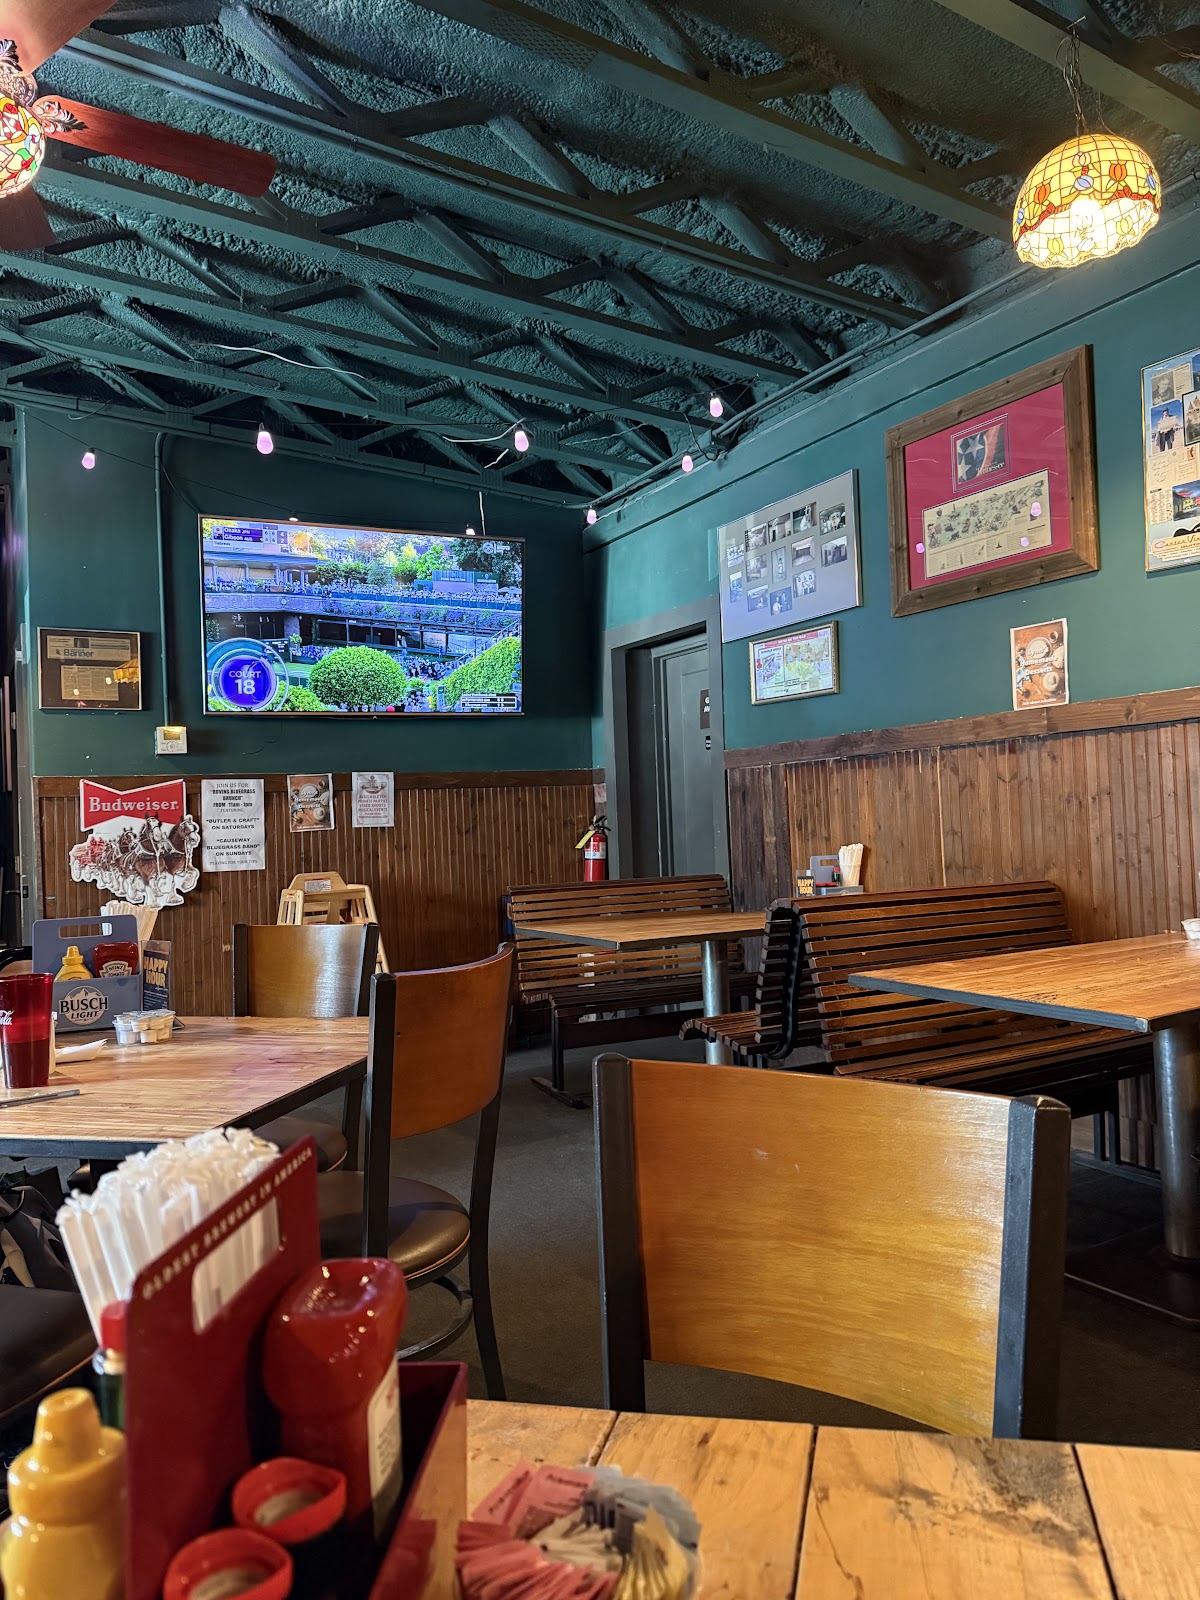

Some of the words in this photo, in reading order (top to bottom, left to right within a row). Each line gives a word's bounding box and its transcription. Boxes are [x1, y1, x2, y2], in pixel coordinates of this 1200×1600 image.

[63, 648, 94, 658] Banner
[1020, 656, 1058, 666] Homemade
[228, 670, 262, 678] COURT
[1025, 667, 1054, 676] Desserts
[234, 679, 256, 695] 18
[89, 796, 178, 812] Budweiser
[797, 879, 814, 887] HAPPY
[144, 956, 168, 973] HAPPY
[146, 970, 166, 988] HOUR
[60, 997, 109, 1013] BUSCH
[71, 1011, 99, 1019] LIGHT
[142, 1243, 199, 1299] OLDEST
[203, 1194, 257, 1248] BREWERY
[260, 1181, 272, 1199] IN
[274, 1147, 313, 1187] AMERICA
